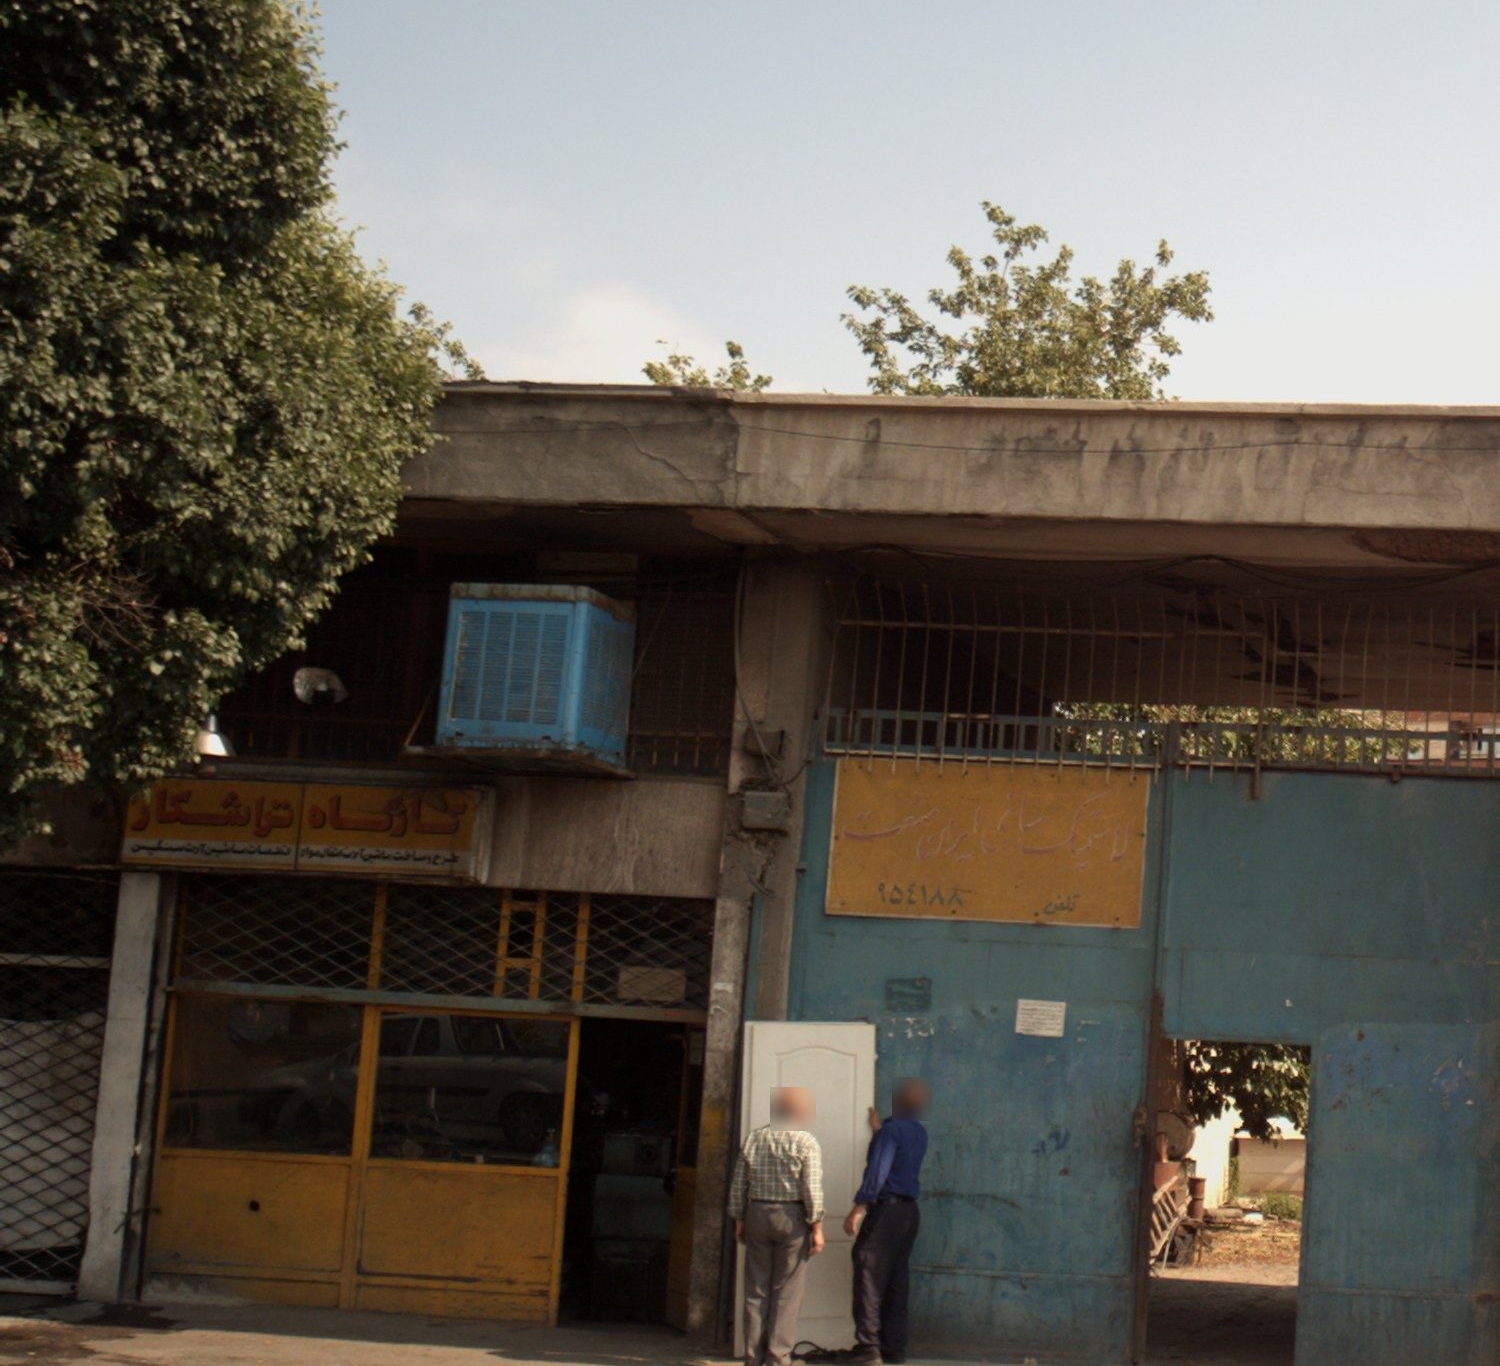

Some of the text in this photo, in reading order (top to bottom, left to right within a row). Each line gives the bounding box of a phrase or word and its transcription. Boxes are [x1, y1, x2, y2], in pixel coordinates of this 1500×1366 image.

[308, 792, 467, 838] کارگاه
[841, 799, 941, 843] صنعت
[916, 805, 984, 863] ایران
[1043, 892, 1081, 916] تلفن
